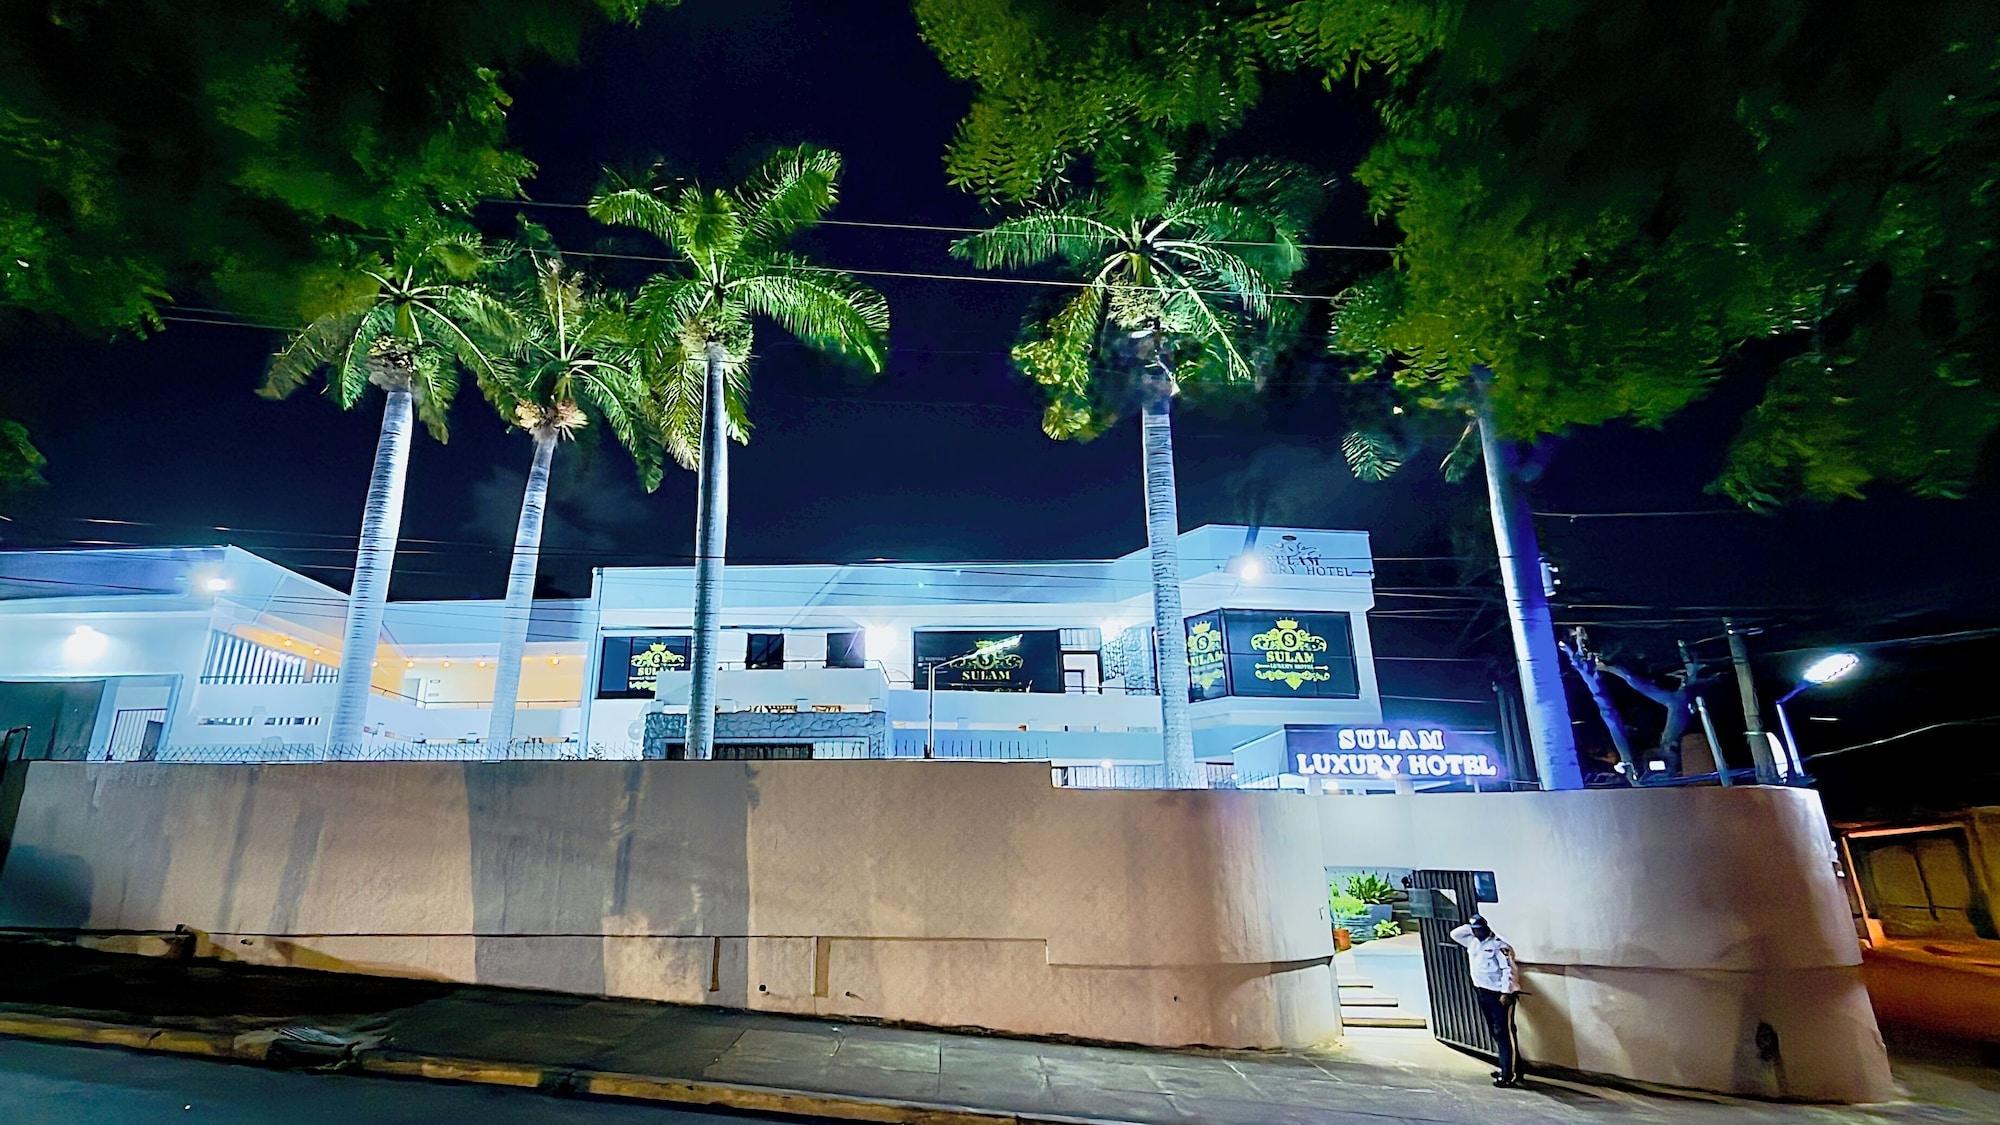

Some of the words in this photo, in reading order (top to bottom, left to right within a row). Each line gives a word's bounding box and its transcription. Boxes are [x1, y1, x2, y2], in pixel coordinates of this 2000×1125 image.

[1307, 566, 1353, 577] HOTEL
[1283, 633, 1295, 648] S
[1266, 651, 1314, 663] SULAM
[962, 670, 1010, 680] SULAM
[1338, 729, 1445, 751] SULAM
[1296, 753, 1402, 776] LUXURY
[1407, 753, 1497, 776] HOTEL
